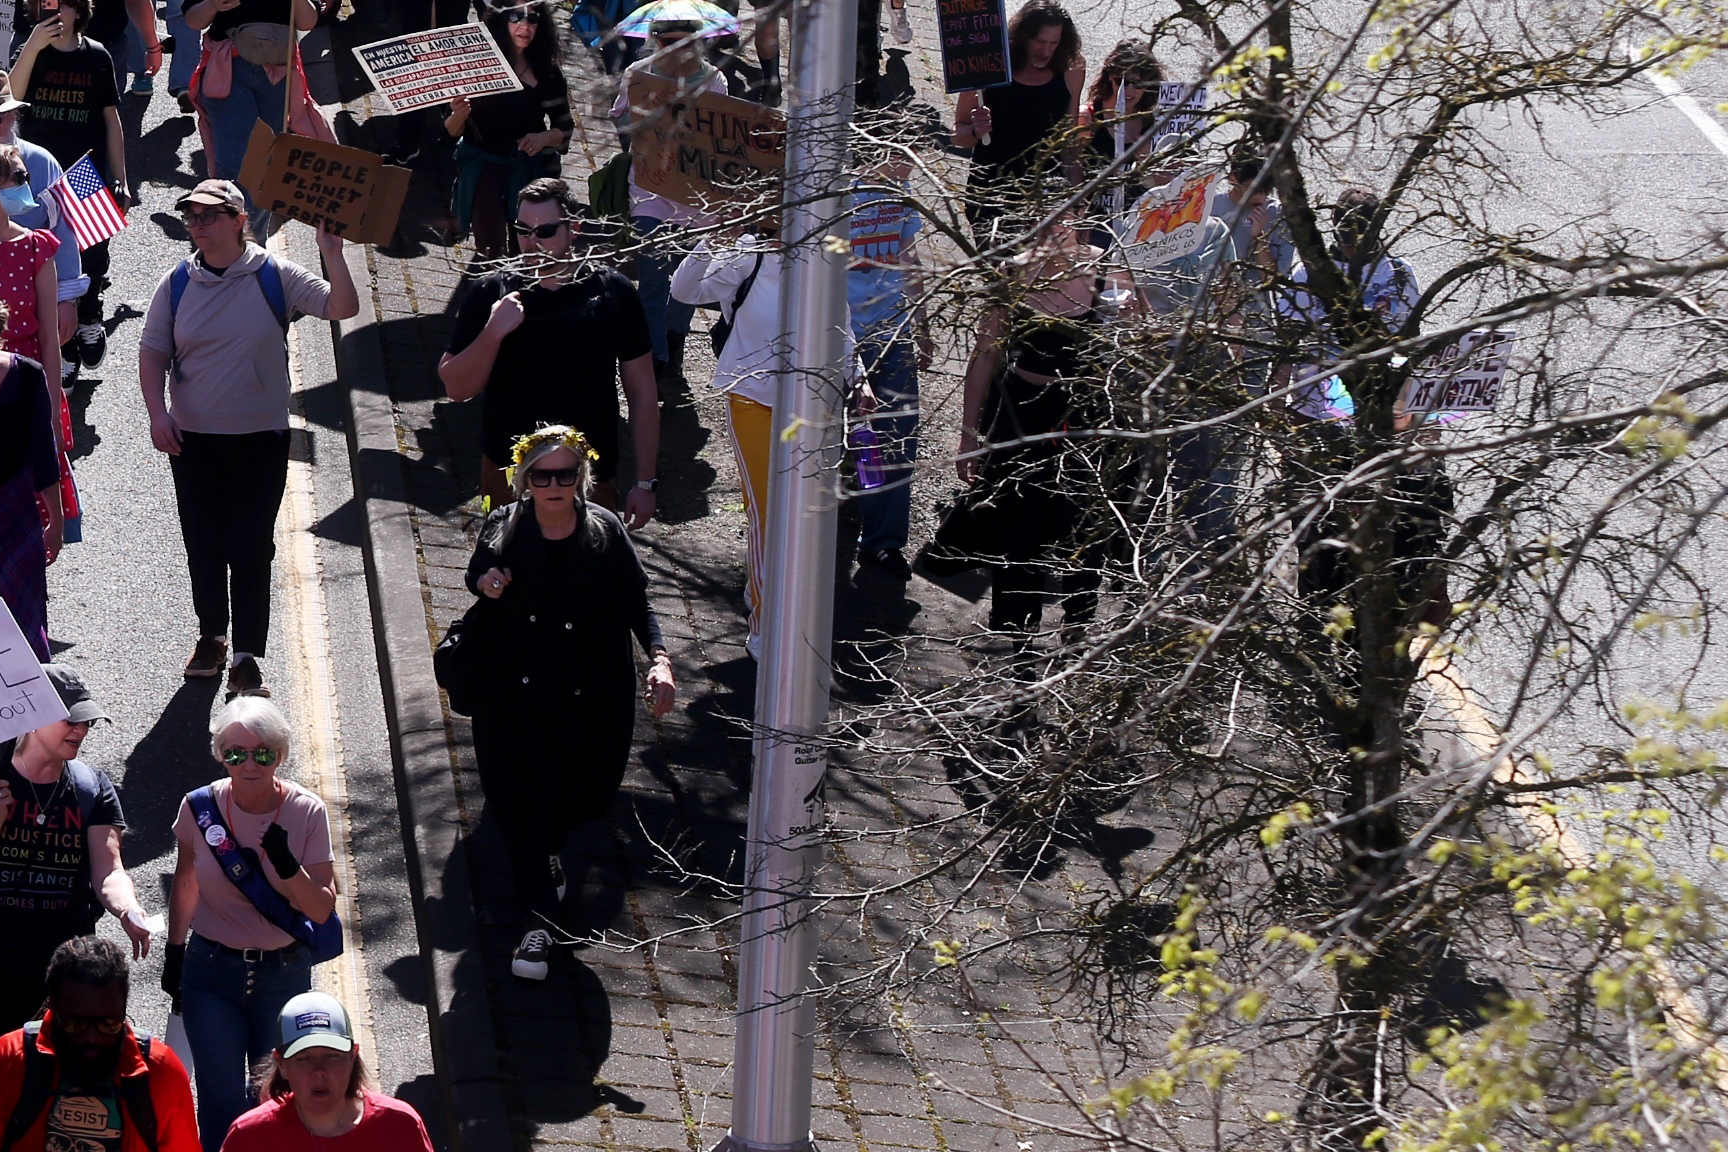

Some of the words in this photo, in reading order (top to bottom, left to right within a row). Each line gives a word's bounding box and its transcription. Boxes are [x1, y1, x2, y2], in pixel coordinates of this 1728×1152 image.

[411, 44, 425, 56] EL
[428, 38, 456, 52] AMOR
[460, 34, 488, 46] GANA
[946, 37, 962, 47] ONE
[968, 32, 990, 44] SIGN
[364, 50, 374, 60] EN
[375, 43, 409, 58] NUESTRA
[428, 51, 444, 60] VIDAS
[444, 48, 464, 57] NEGRAS
[381, 80, 393, 88] LAS
[395, 68, 445, 84] DISCAPACIDADES
[446, 65, 460, 74] SON
[461, 58, 500, 70] RESPETADAS
[948, 58, 966, 76] NO
[398, 80, 424, 90] MUJERES
[484, 66, 506, 74] CUERPO
[49, 89, 85, 104] MELTS
[392, 100, 404, 108] SE
[408, 90, 446, 106] CELEBRA
[450, 88, 462, 96] LA
[464, 79, 514, 94] DIVERSIDAD
[68, 108, 90, 123] RISE
[287, 148, 368, 184] PEOPLE
[282, 172, 362, 204] PLANET
[294, 190, 342, 214] OVER
[55, 852, 82, 864] LAW
[42, 900, 69, 910] DUTY
